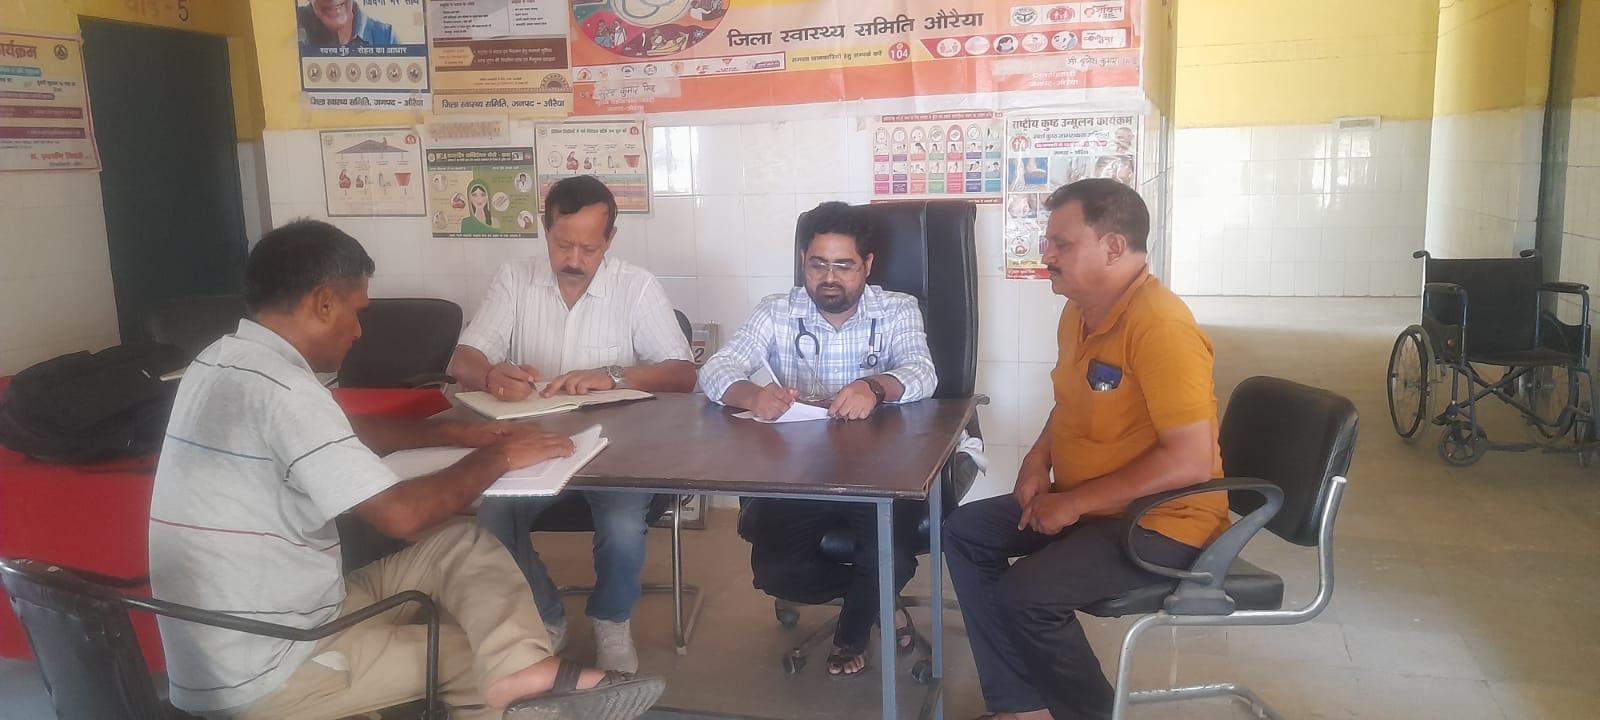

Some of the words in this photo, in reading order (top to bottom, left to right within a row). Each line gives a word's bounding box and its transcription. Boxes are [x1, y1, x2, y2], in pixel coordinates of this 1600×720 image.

[177, 0, 190, 21] 5
[727, 28, 773, 48] जिला
[780, 24, 846, 43] स्वास्थ्य
[854, 14, 915, 37] समिति
[924, 8, 985, 30] औरैया
[890, 48, 909, 60] 104
[442, 99, 459, 108] जिला
[511, 100, 535, 108] जनपद
[1012, 117, 1039, 132] राष्ट्रीय
[1041, 118, 1059, 131] कुष्ठ
[1061, 117, 1094, 129] उन्मूलन
